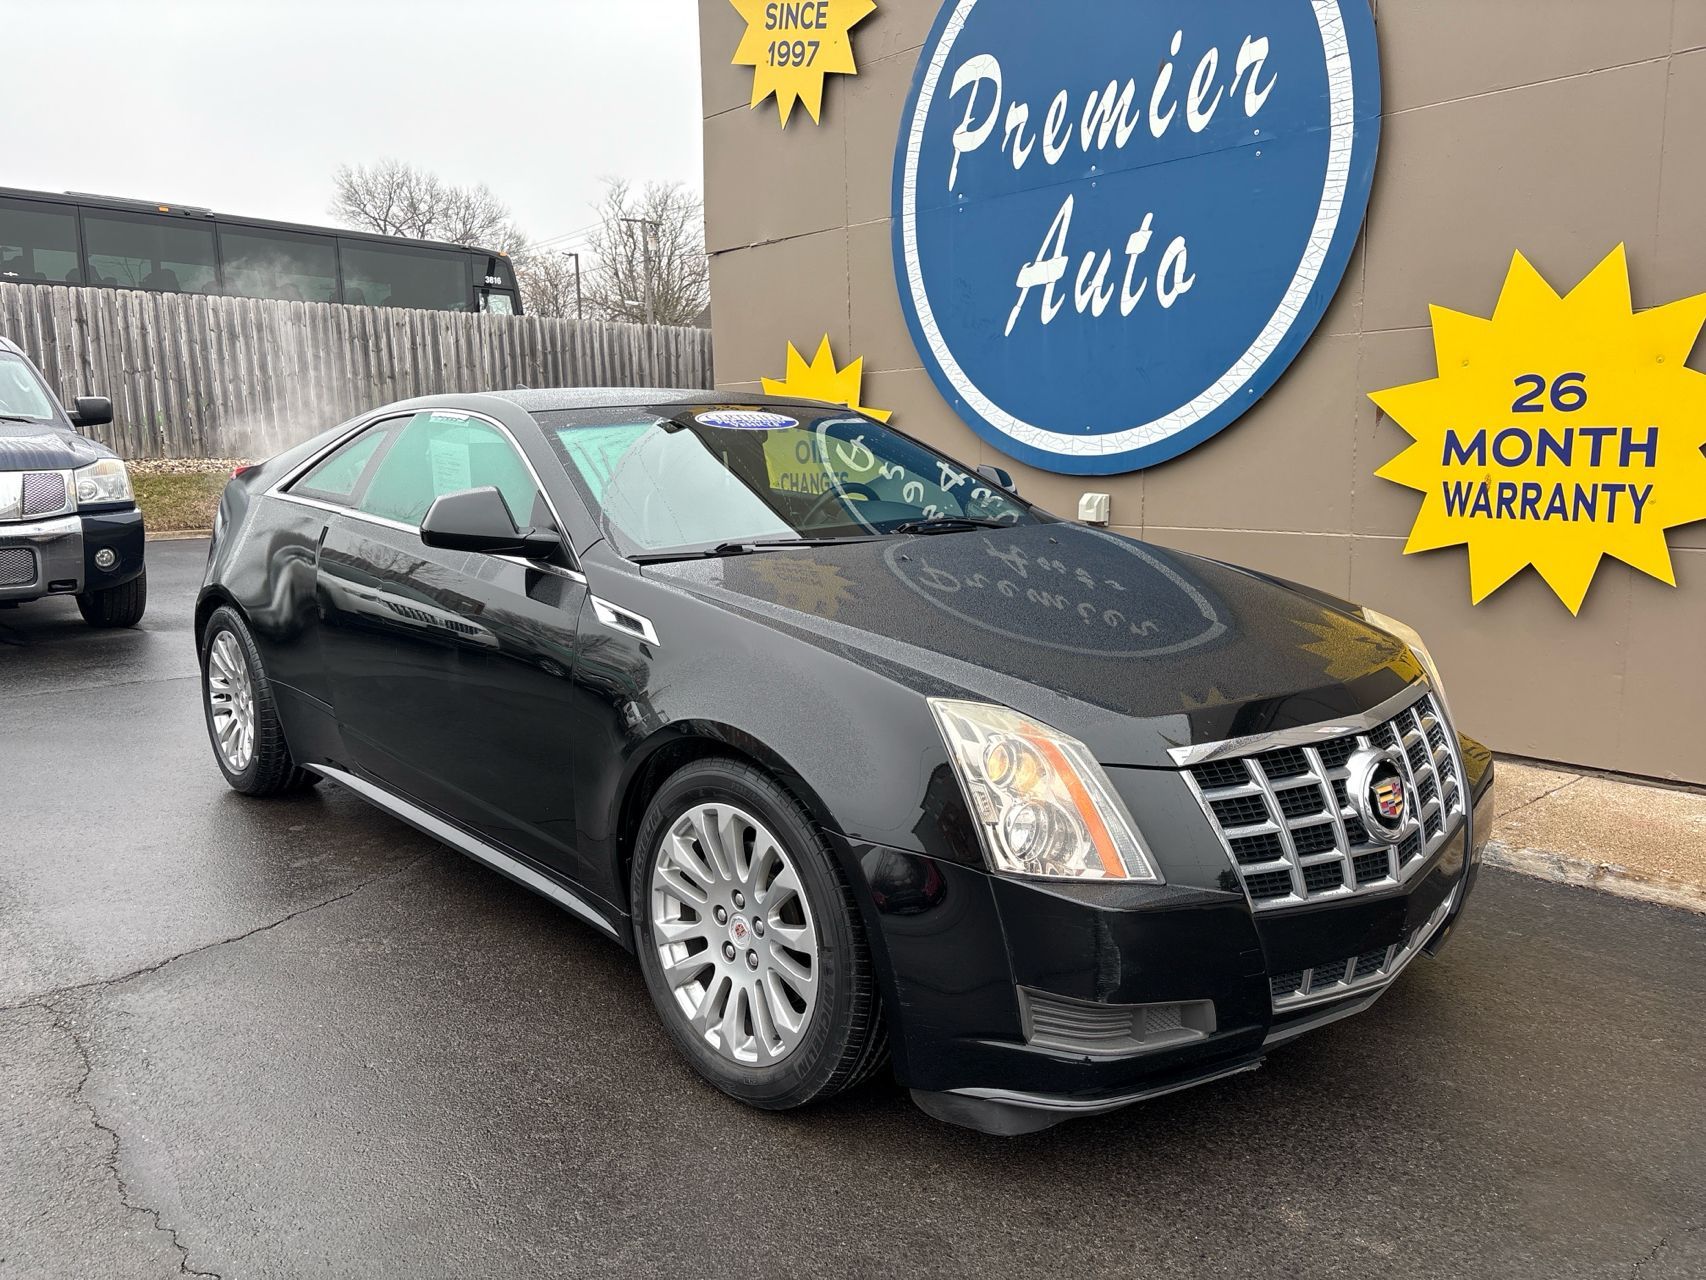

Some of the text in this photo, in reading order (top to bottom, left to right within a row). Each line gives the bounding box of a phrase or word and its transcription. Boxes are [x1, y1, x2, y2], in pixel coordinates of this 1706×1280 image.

[765, 1, 829, 30] SINCE
[768, 40, 820, 67] 1997
[949, 29, 1277, 192] Premier
[1004, 193, 1196, 337] Auto
[1511, 372, 1588, 414] 26
[1441, 426, 1659, 468] MONTH
[1442, 480, 1654, 525] WARRANTY
